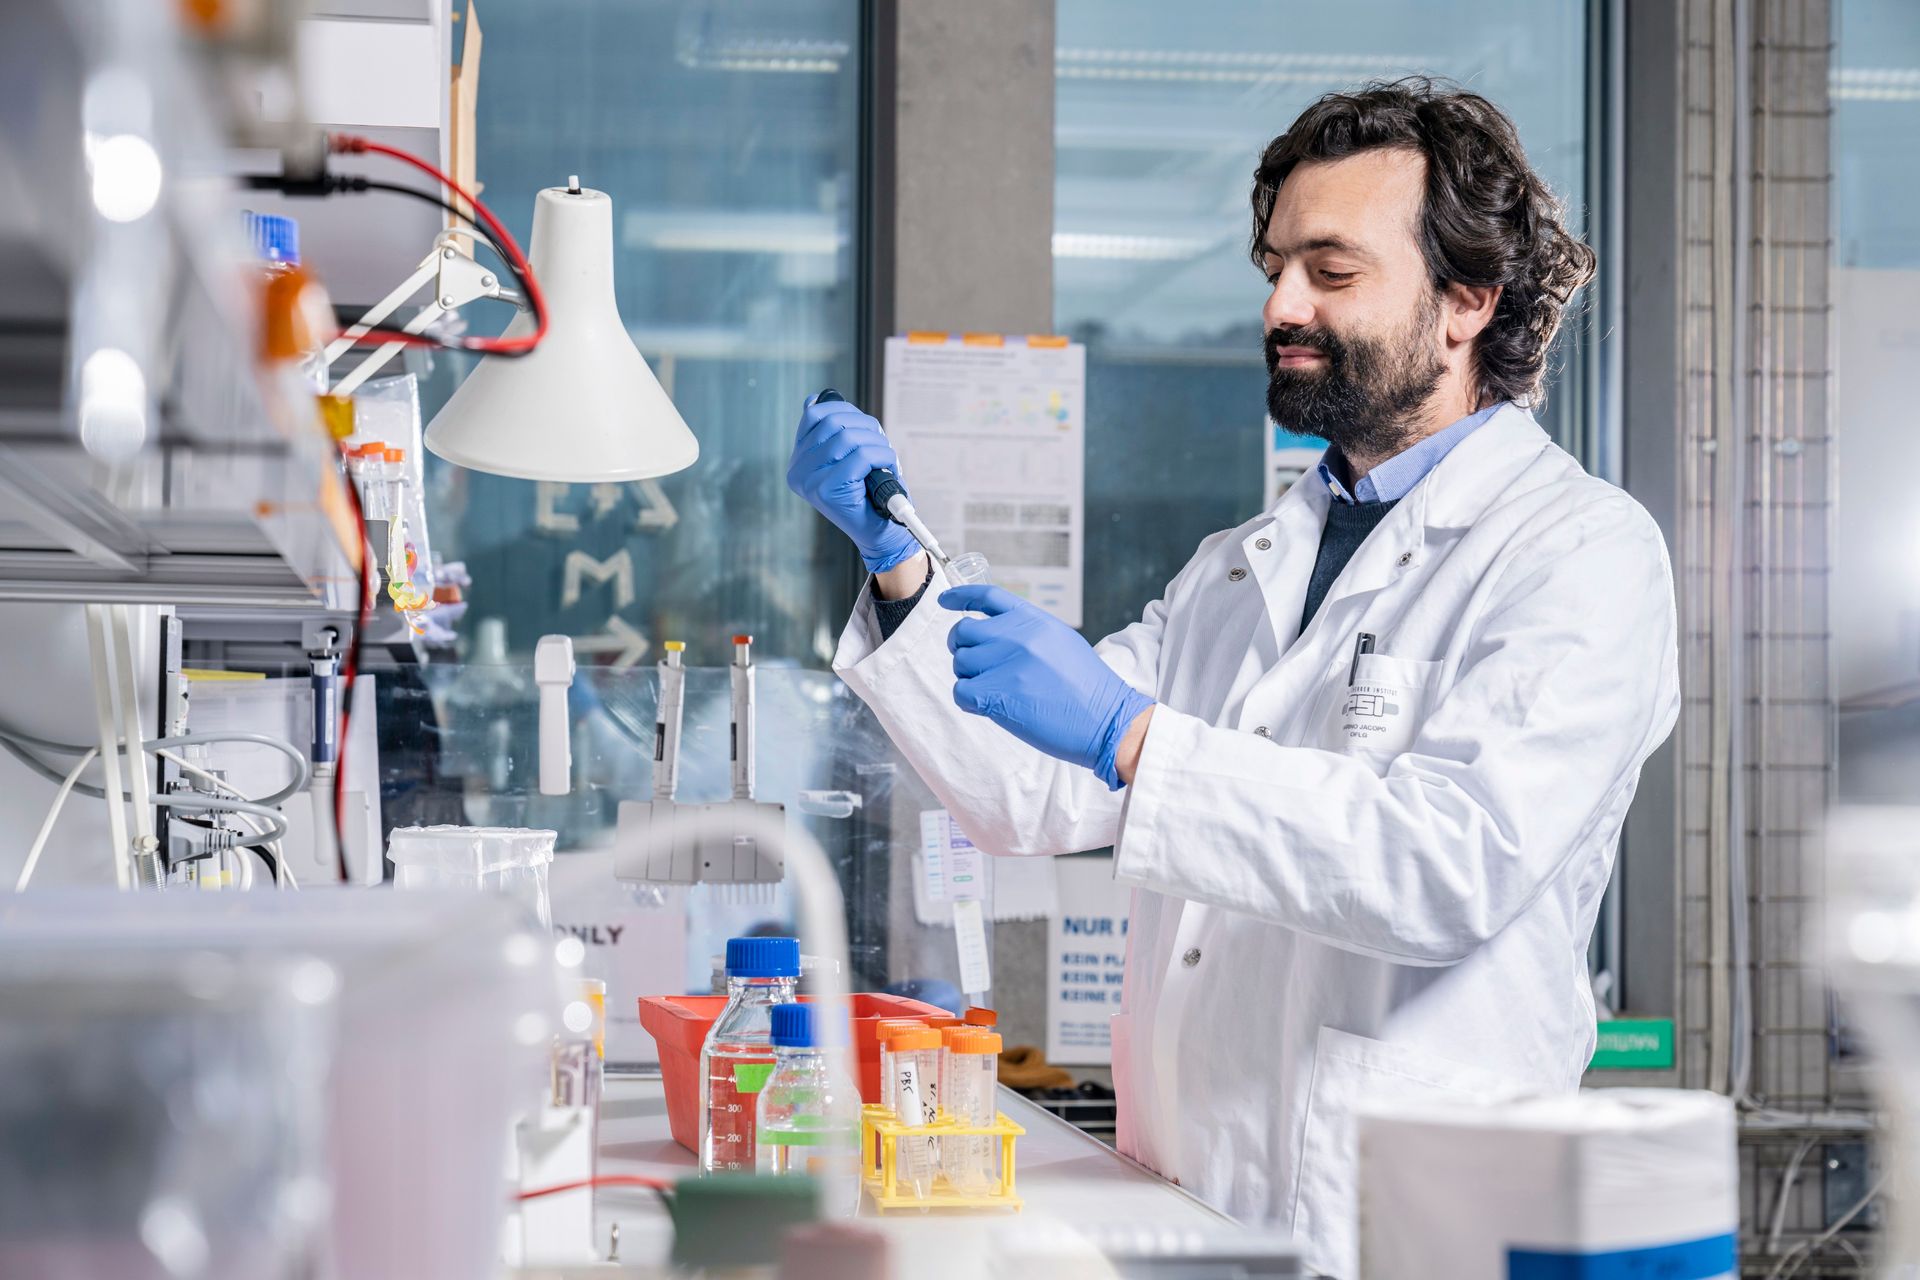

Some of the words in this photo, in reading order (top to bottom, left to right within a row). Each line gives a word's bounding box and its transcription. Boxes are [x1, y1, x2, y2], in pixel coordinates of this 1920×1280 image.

[1359, 724, 1387, 732] JACOPO
[1063, 917, 1113, 935] NUR
[728, 1104, 742, 1113] 300
[728, 1134, 742, 1143] 200
[727, 1161, 742, 1170] 100
